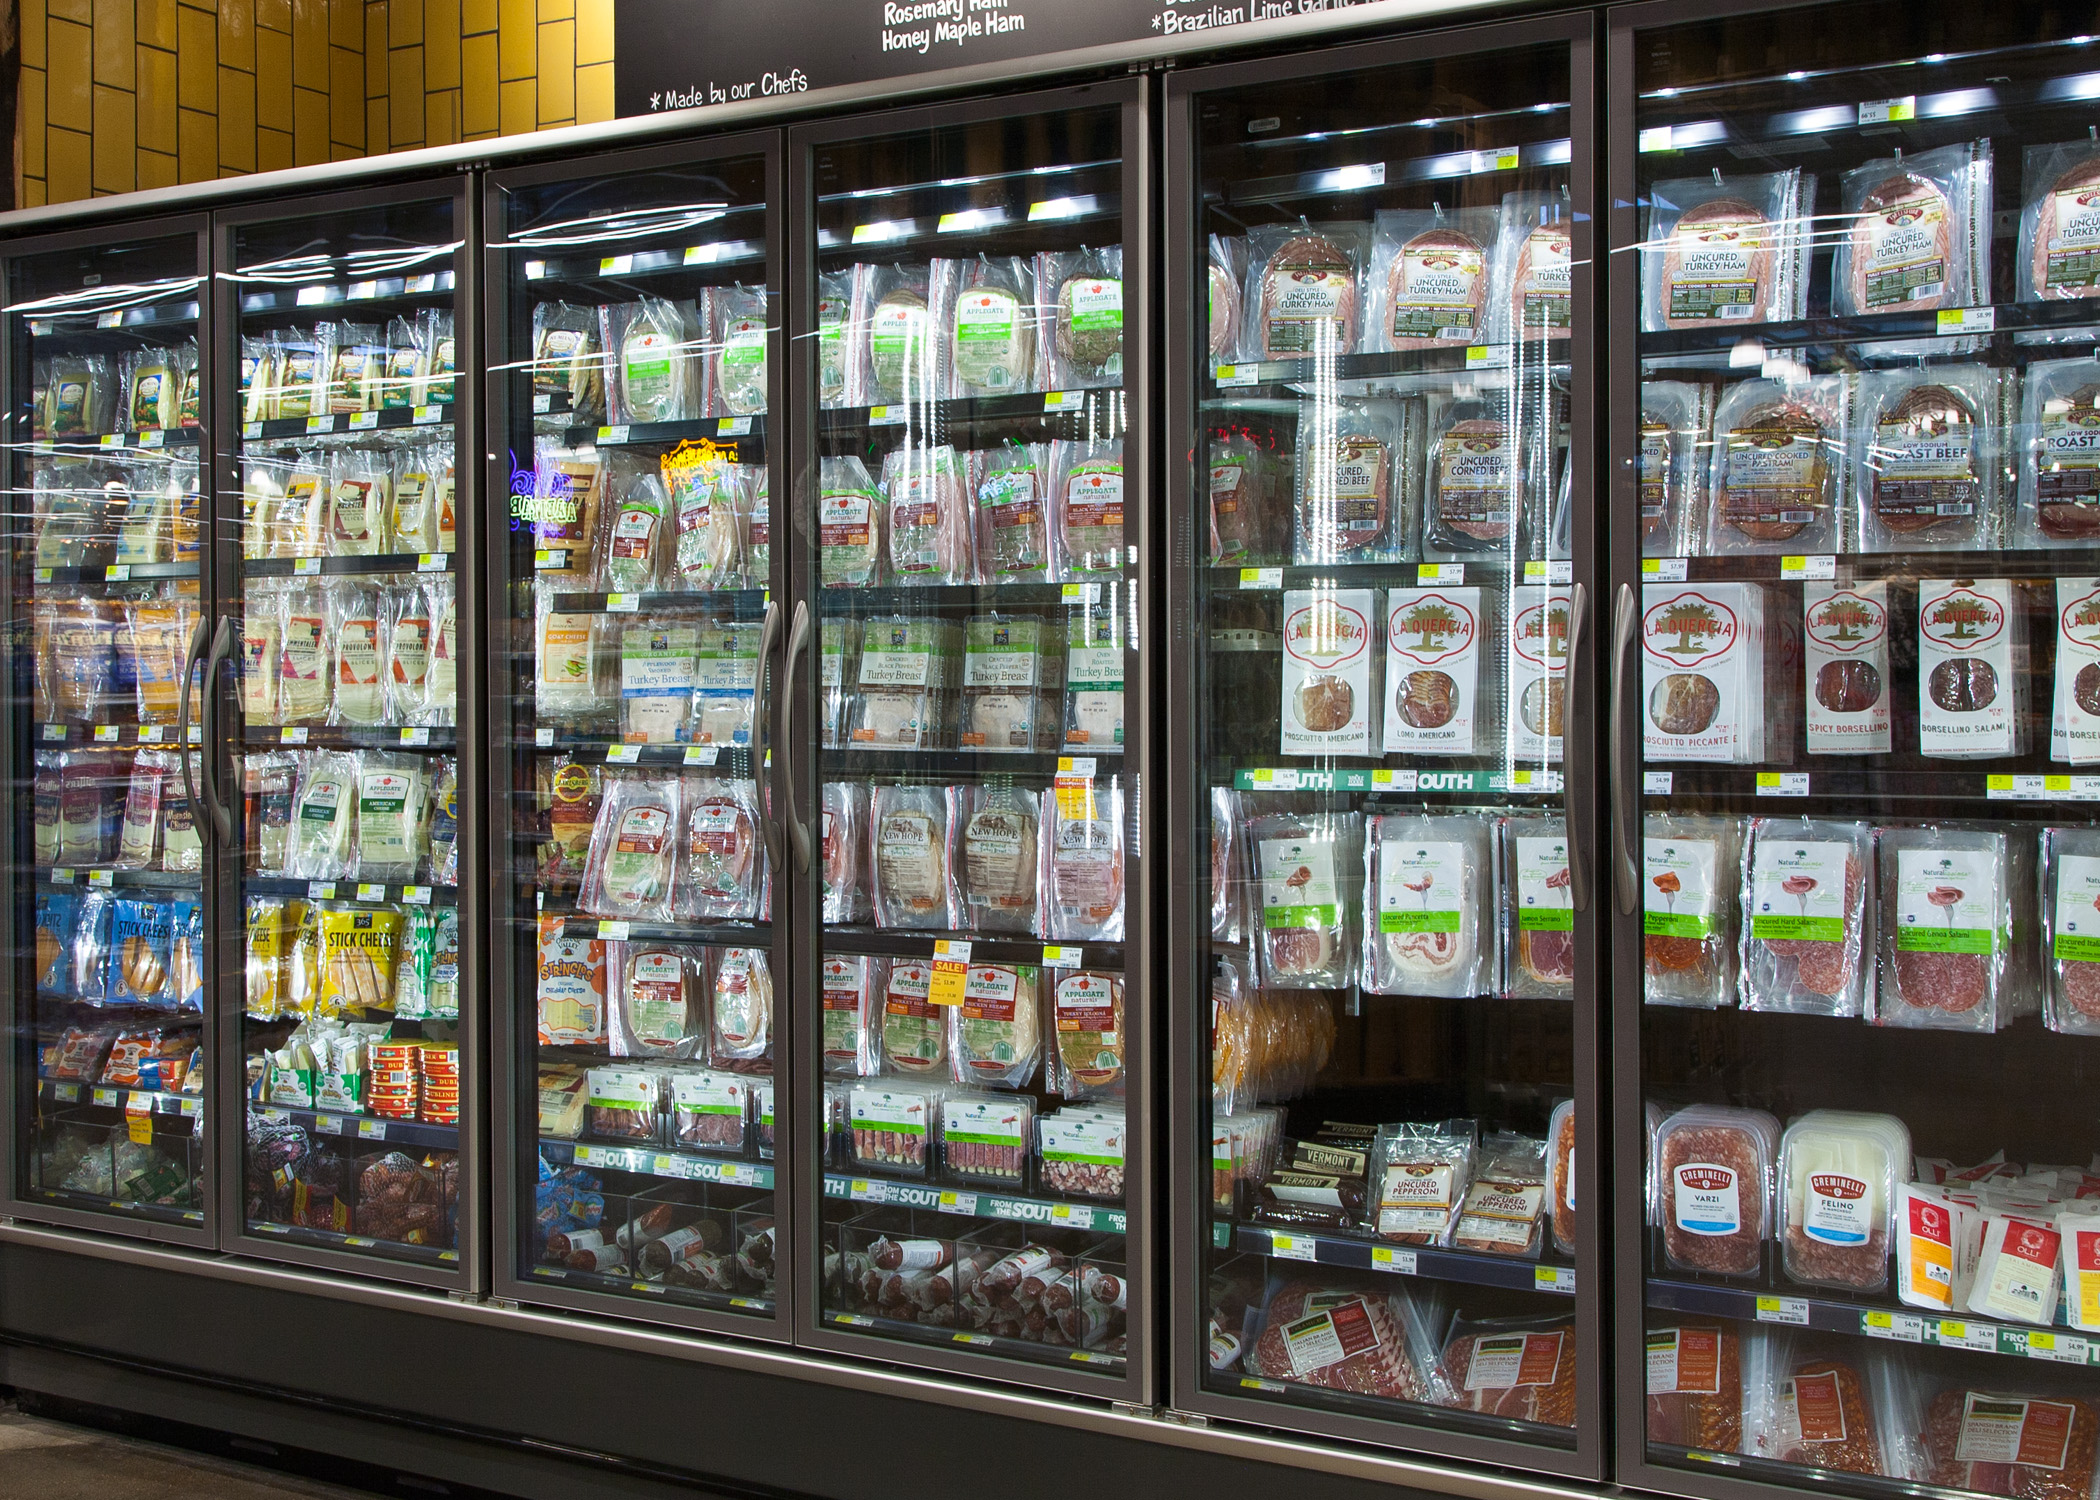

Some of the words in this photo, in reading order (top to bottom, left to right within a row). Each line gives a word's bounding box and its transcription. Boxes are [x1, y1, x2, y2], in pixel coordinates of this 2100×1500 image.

[885, 0, 963, 25] Rosemary
[1250, 0, 1292, 22] Lime
[882, 29, 929, 54] Honey
[935, 22, 982, 46] Maple
[986, 11, 1024, 35] Ham
[665, 90, 703, 110] Made
[710, 82, 726, 104] by
[731, 80, 756, 100] our
[761, 68, 808, 96] Chefs
[1882, 232, 1924, 248] UNCURED
[1876, 245, 1910, 259] TURKEY
[1911, 239, 1932, 250] HAM
[1690, 252, 1738, 263] UNCURED
[1684, 261, 1722, 272] TURKEY
[1723, 261, 1746, 271] HAM
[1415, 278, 1459, 288] UNCURED
[1286, 292, 1327, 301] UNCURED
[1408, 286, 1441, 296] TURKEY
[1442, 286, 1467, 296] HAM
[1078, 294, 1117, 304] APPLEGATE
[1280, 300, 1312, 309] TURKEY
[1313, 300, 1335, 309] HAM
[966, 307, 1004, 315] APPLEGATE
[2047, 436, 2095, 448] ROAST
[1936, 447, 1968, 459] BEEF
[1460, 456, 1502, 466] UNCURED
[1451, 465, 1490, 476] CORNED
[1352, 475, 1371, 486] BEEF
[1077, 487, 1117, 495] APPLEGATE
[1924, 614, 1942, 627] LA
[1944, 610, 2000, 624] QUERCIA
[2065, 616, 2084, 629] LA
[1392, 622, 1408, 636] LA
[1412, 618, 1469, 636] QUERCIA
[1646, 622, 1661, 637] LA
[1668, 618, 1732, 637] QUERCIA
[1516, 626, 1534, 640] LA
[866, 670, 895, 681] Turkey
[895, 671, 922, 681] Breast
[970, 671, 1000, 682] Turkey
[1001, 671, 1029, 681] Breast
[1074, 666, 1102, 678] Turkey
[629, 674, 660, 685] Turkey
[662, 674, 691, 684] Breast
[702, 675, 727, 685] Turkey
[1808, 723, 1834, 734] SPICY
[1836, 722, 1889, 734] BORSELLINO
[1922, 723, 1970, 734] BORSELLINO
[1974, 723, 2006, 732] SALAMI
[1284, 732, 1322, 742] PROSCIUTTO
[1326, 732, 1364, 743] AMERICANO
[1397, 730, 1415, 739] LOMO
[1418, 730, 1456, 739] AMERICANO
[1688, 736, 1728, 744] PICCANTE
[2025, 780, 2042, 788] $4.99
[900, 831, 924, 840] HOPE
[971, 827, 990, 836] NEW
[992, 829, 1018, 839] HOPE
[118, 921, 140, 936] STICK
[329, 931, 357, 947] STICK
[359, 932, 395, 948] CHEESE
[640, 966, 675, 974] APPLEGATE
[935, 961, 964, 972] SALE!
[970, 982, 1009, 991] APPLEGATE
[1307, 1150, 1350, 1167] VERMONT
[1682, 1169, 1732, 1184] CREMINELLI
[1398, 1181, 1437, 1189] UNCURED
[1812, 1176, 1864, 1194] CREMINELLI
[1393, 1187, 1439, 1196] PEPPERONI
[990, 1200, 1012, 1208] FROM
[1694, 1195, 1719, 1203] VARZI
[1821, 1199, 1854, 1210] FELINO
[996, 1207, 1012, 1216] THE
[1921, 1226, 1940, 1237] OLLI
[2016, 1246, 2039, 1257] OLLI
[1904, 1320, 1920, 1329] $4.99
[1978, 1330, 1994, 1338] $4.99
